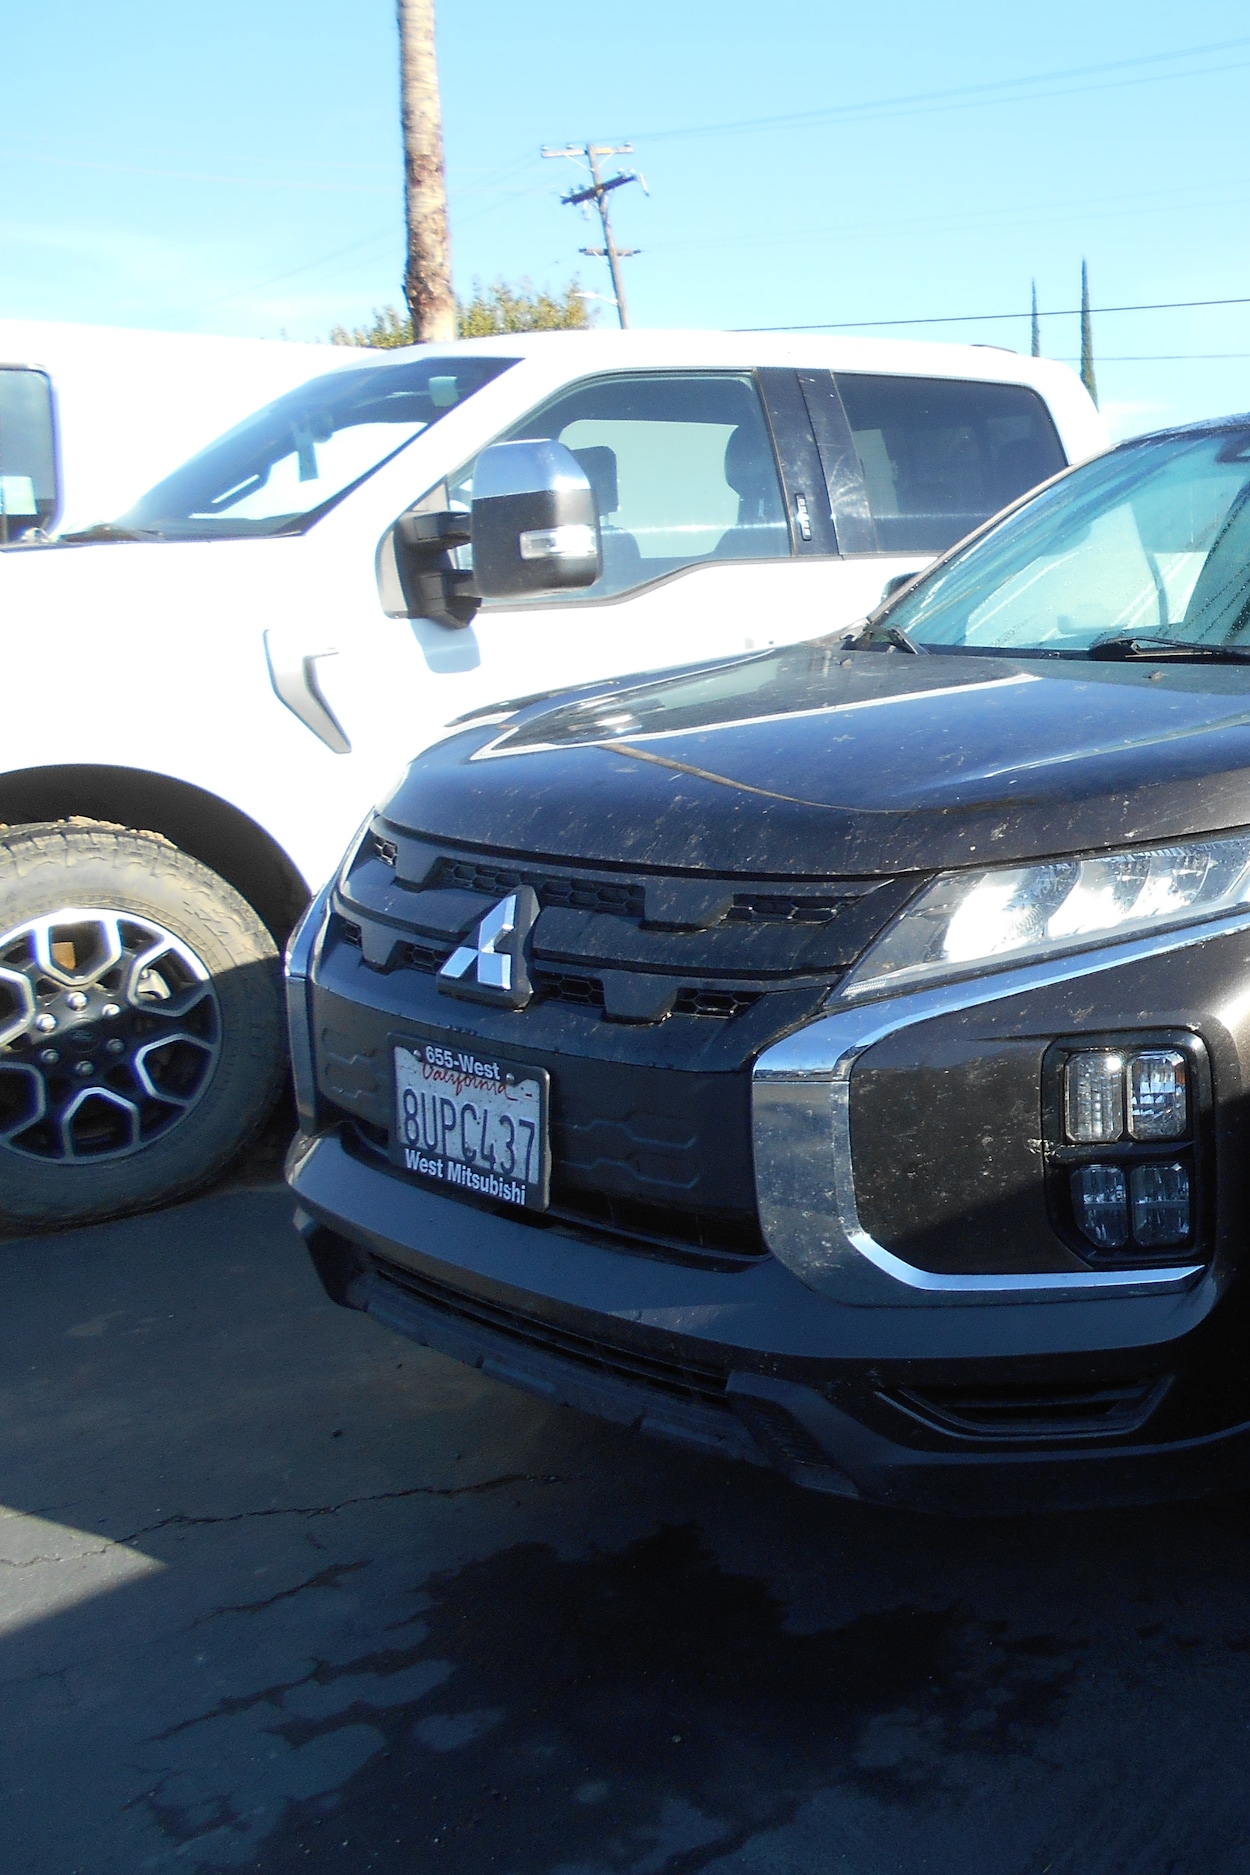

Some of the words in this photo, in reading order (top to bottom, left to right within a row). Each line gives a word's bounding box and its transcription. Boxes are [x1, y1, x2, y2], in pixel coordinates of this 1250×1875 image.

[422, 1063, 518, 1101] California
[425, 1045, 501, 1081] 655-West
[403, 1088, 535, 1183] 8UPC437
[405, 1149, 443, 1178] West
[447, 1162, 526, 1205] Mitsubishi
